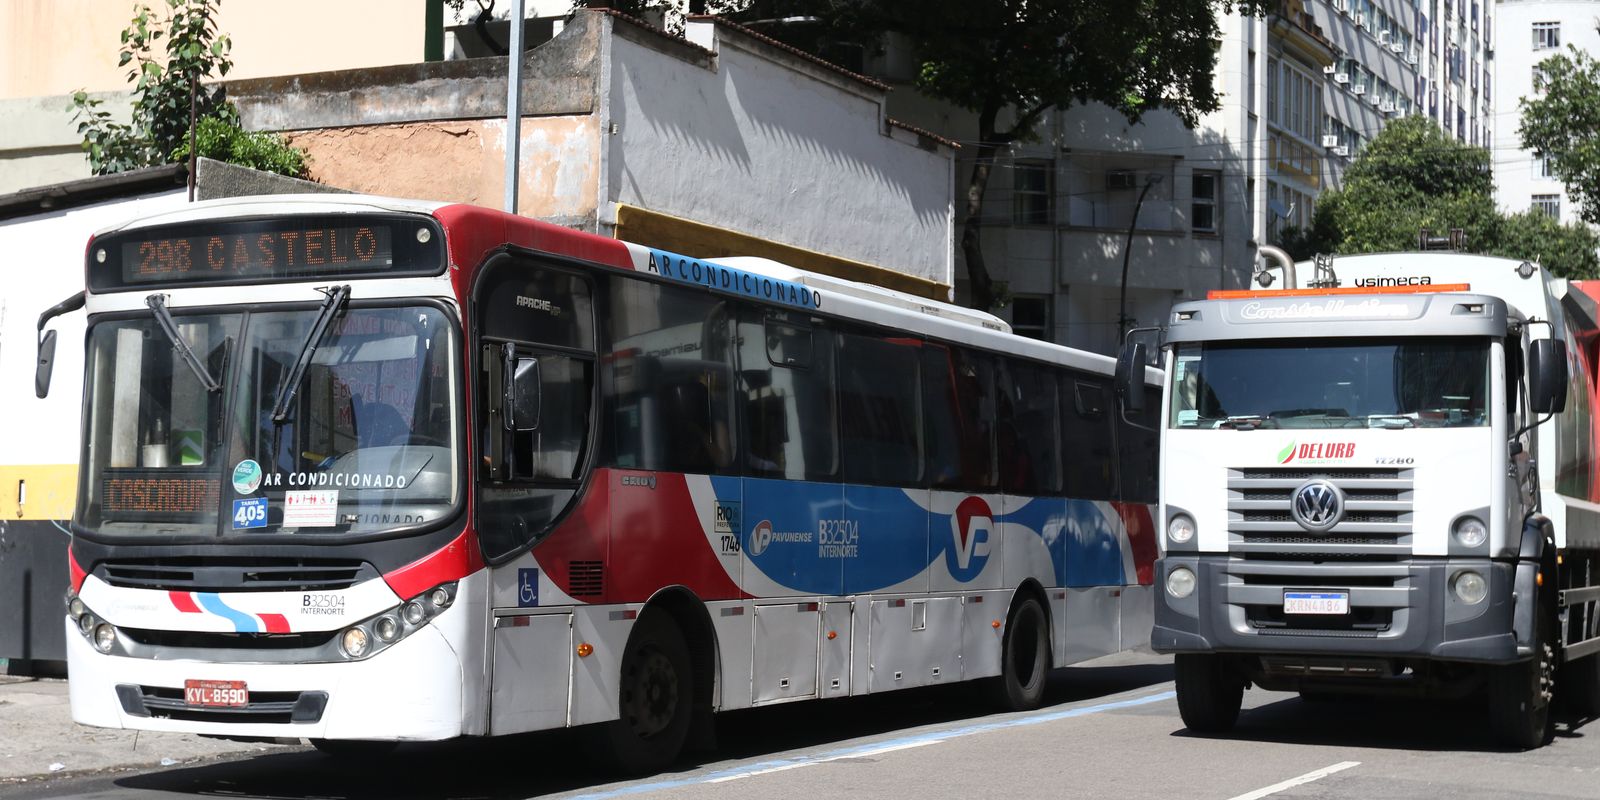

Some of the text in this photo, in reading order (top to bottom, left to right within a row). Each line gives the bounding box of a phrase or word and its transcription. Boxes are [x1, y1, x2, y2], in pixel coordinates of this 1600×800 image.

[139, 227, 377, 274] 298 CASTELO
[648, 251, 822, 309] AR CONDICIONADO
[1354, 274, 1432, 288] usimeca
[516, 295, 551, 311] APACHE
[1298, 442, 1356, 459] DELURB
[264, 472, 406, 489] AR CONDICIONADO
[716, 506, 733, 521] RIO
[771, 532, 813, 542] PAVUNENSE
[818, 519, 859, 545] B32504
[949, 511, 994, 569] VP
[720, 535, 740, 553] 1746
[818, 544, 858, 558] INTERNORTE
[303, 594, 345, 608] B32504
[300, 607, 345, 616] INTERNORTE
